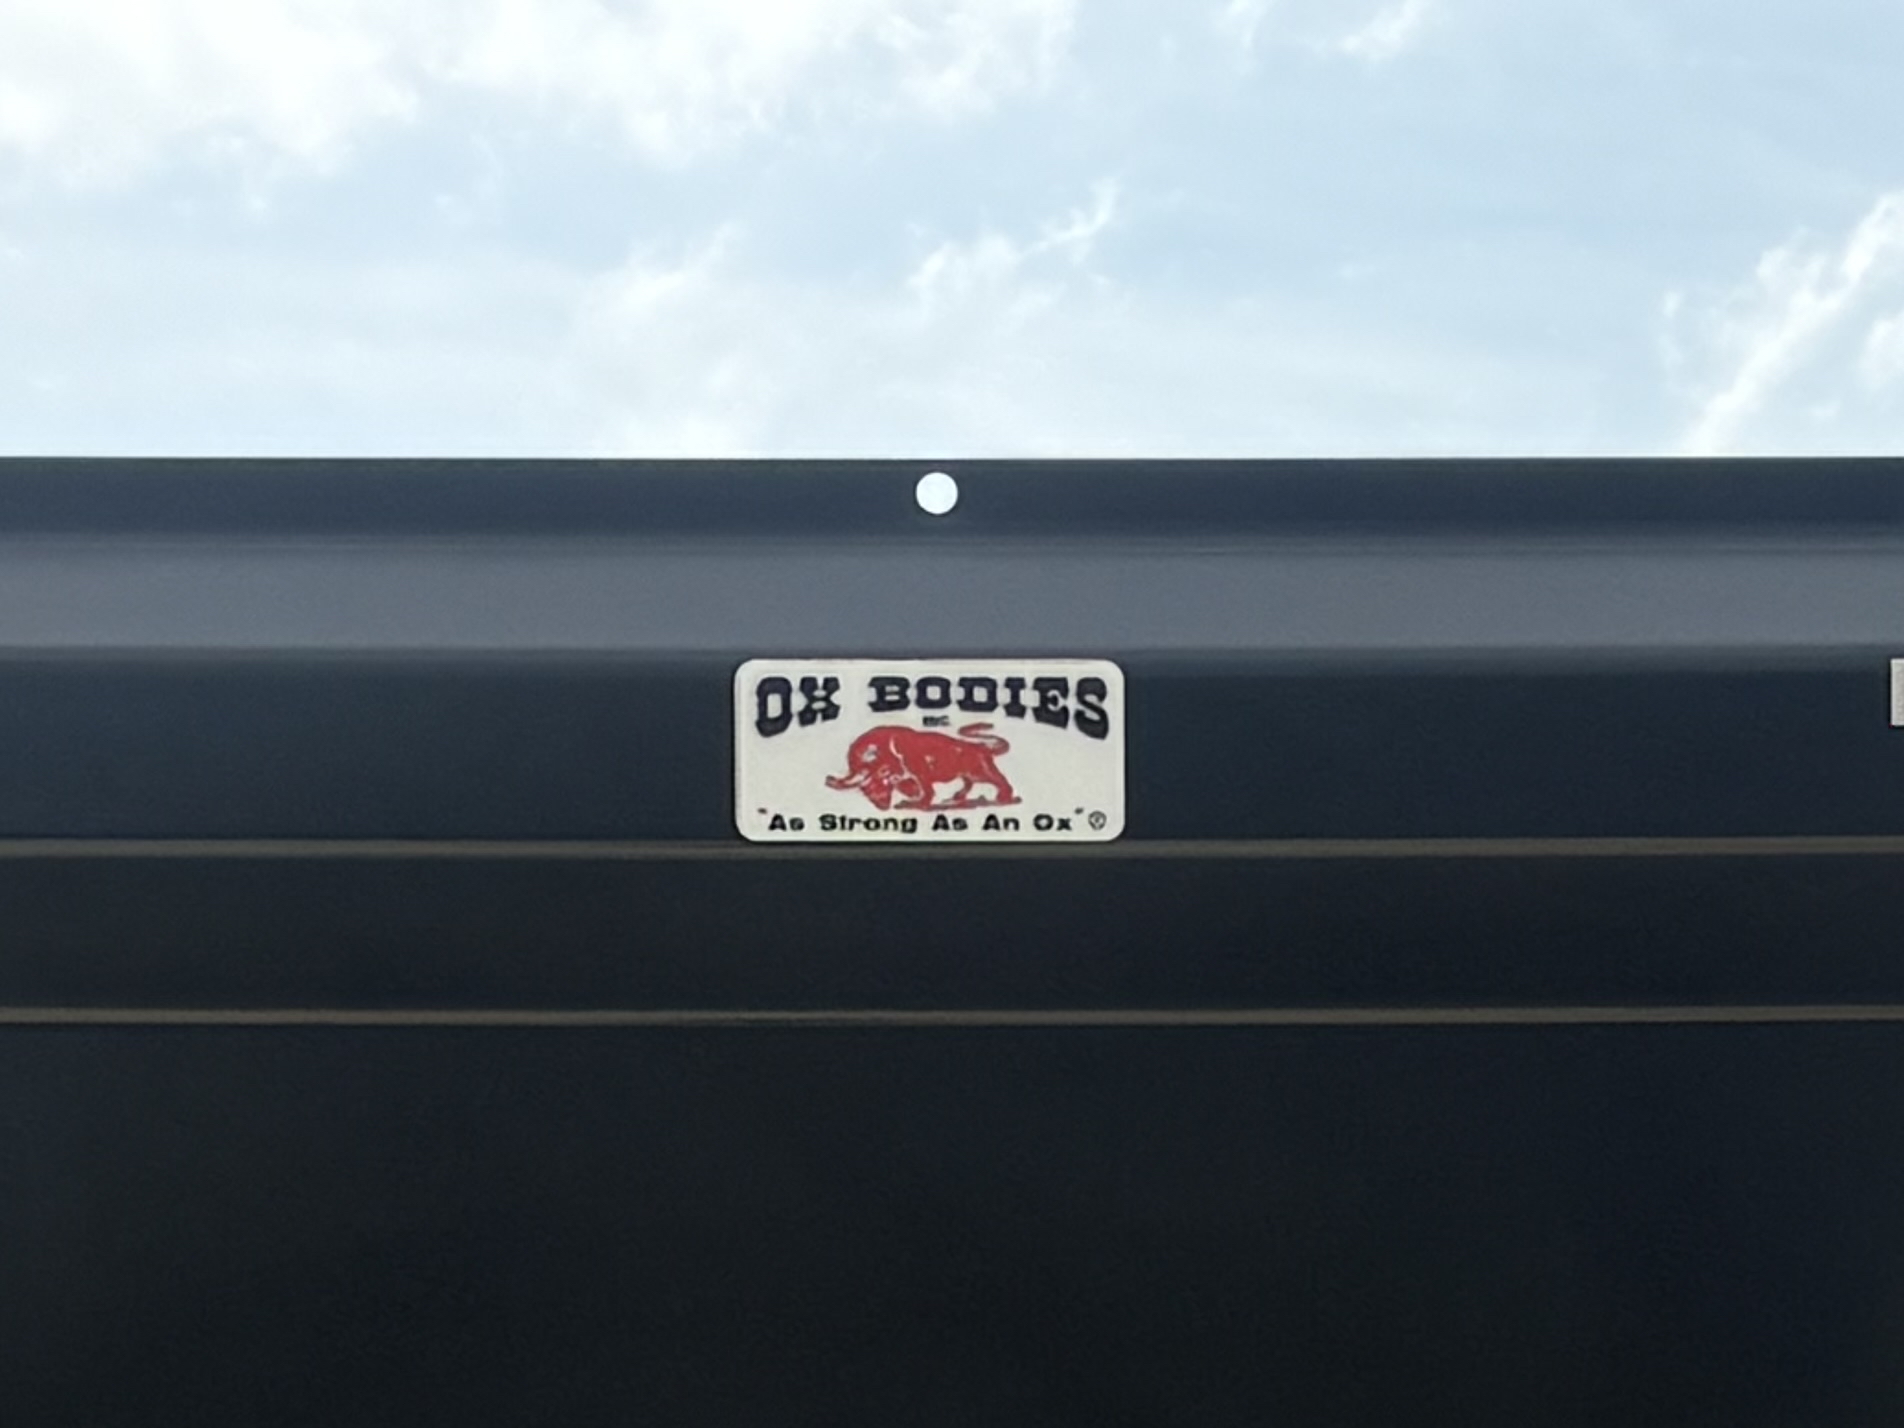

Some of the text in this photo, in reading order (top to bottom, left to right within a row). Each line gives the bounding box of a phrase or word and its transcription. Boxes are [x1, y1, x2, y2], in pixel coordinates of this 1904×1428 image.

[754, 675, 1111, 741] OX BODIES
[818, 813, 919, 835] Strong
[931, 813, 970, 832] As
[981, 813, 1021, 832] An
